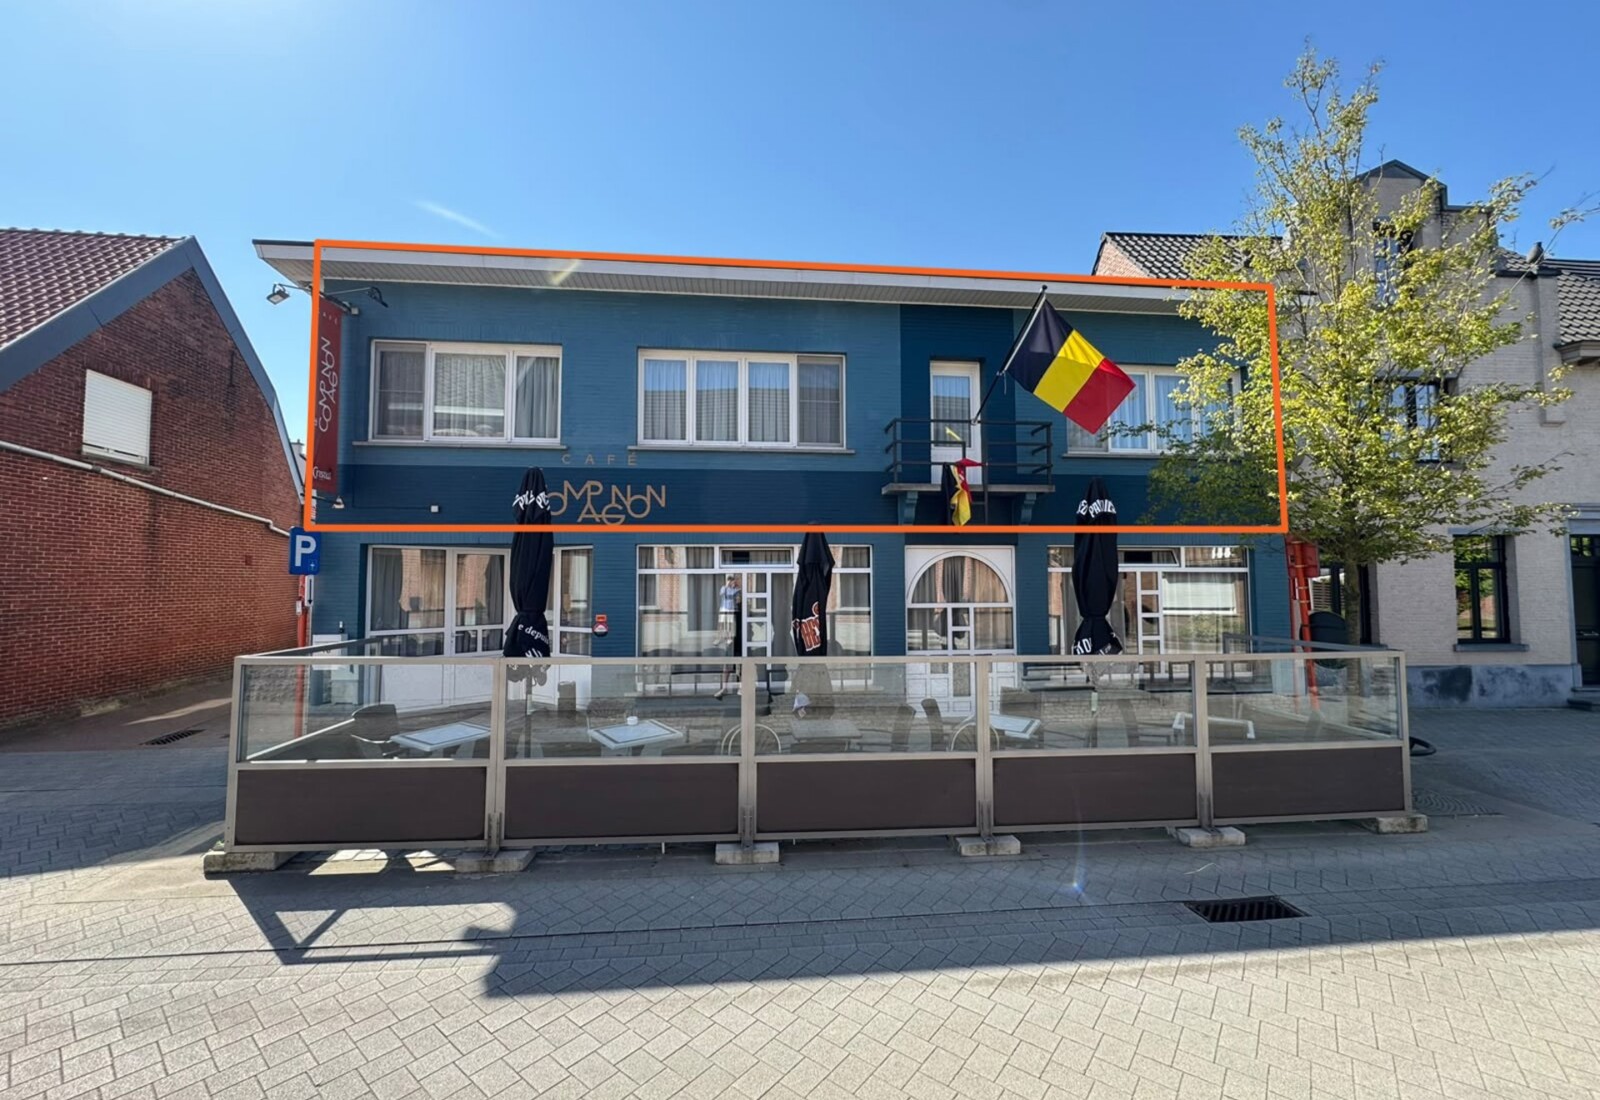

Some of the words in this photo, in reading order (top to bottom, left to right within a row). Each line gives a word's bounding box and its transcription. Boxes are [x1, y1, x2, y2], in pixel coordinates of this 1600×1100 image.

[561, 452, 638, 466] CAFÉ
[547, 480, 666, 526] OMPAGNON
[294, 534, 317, 567] P
